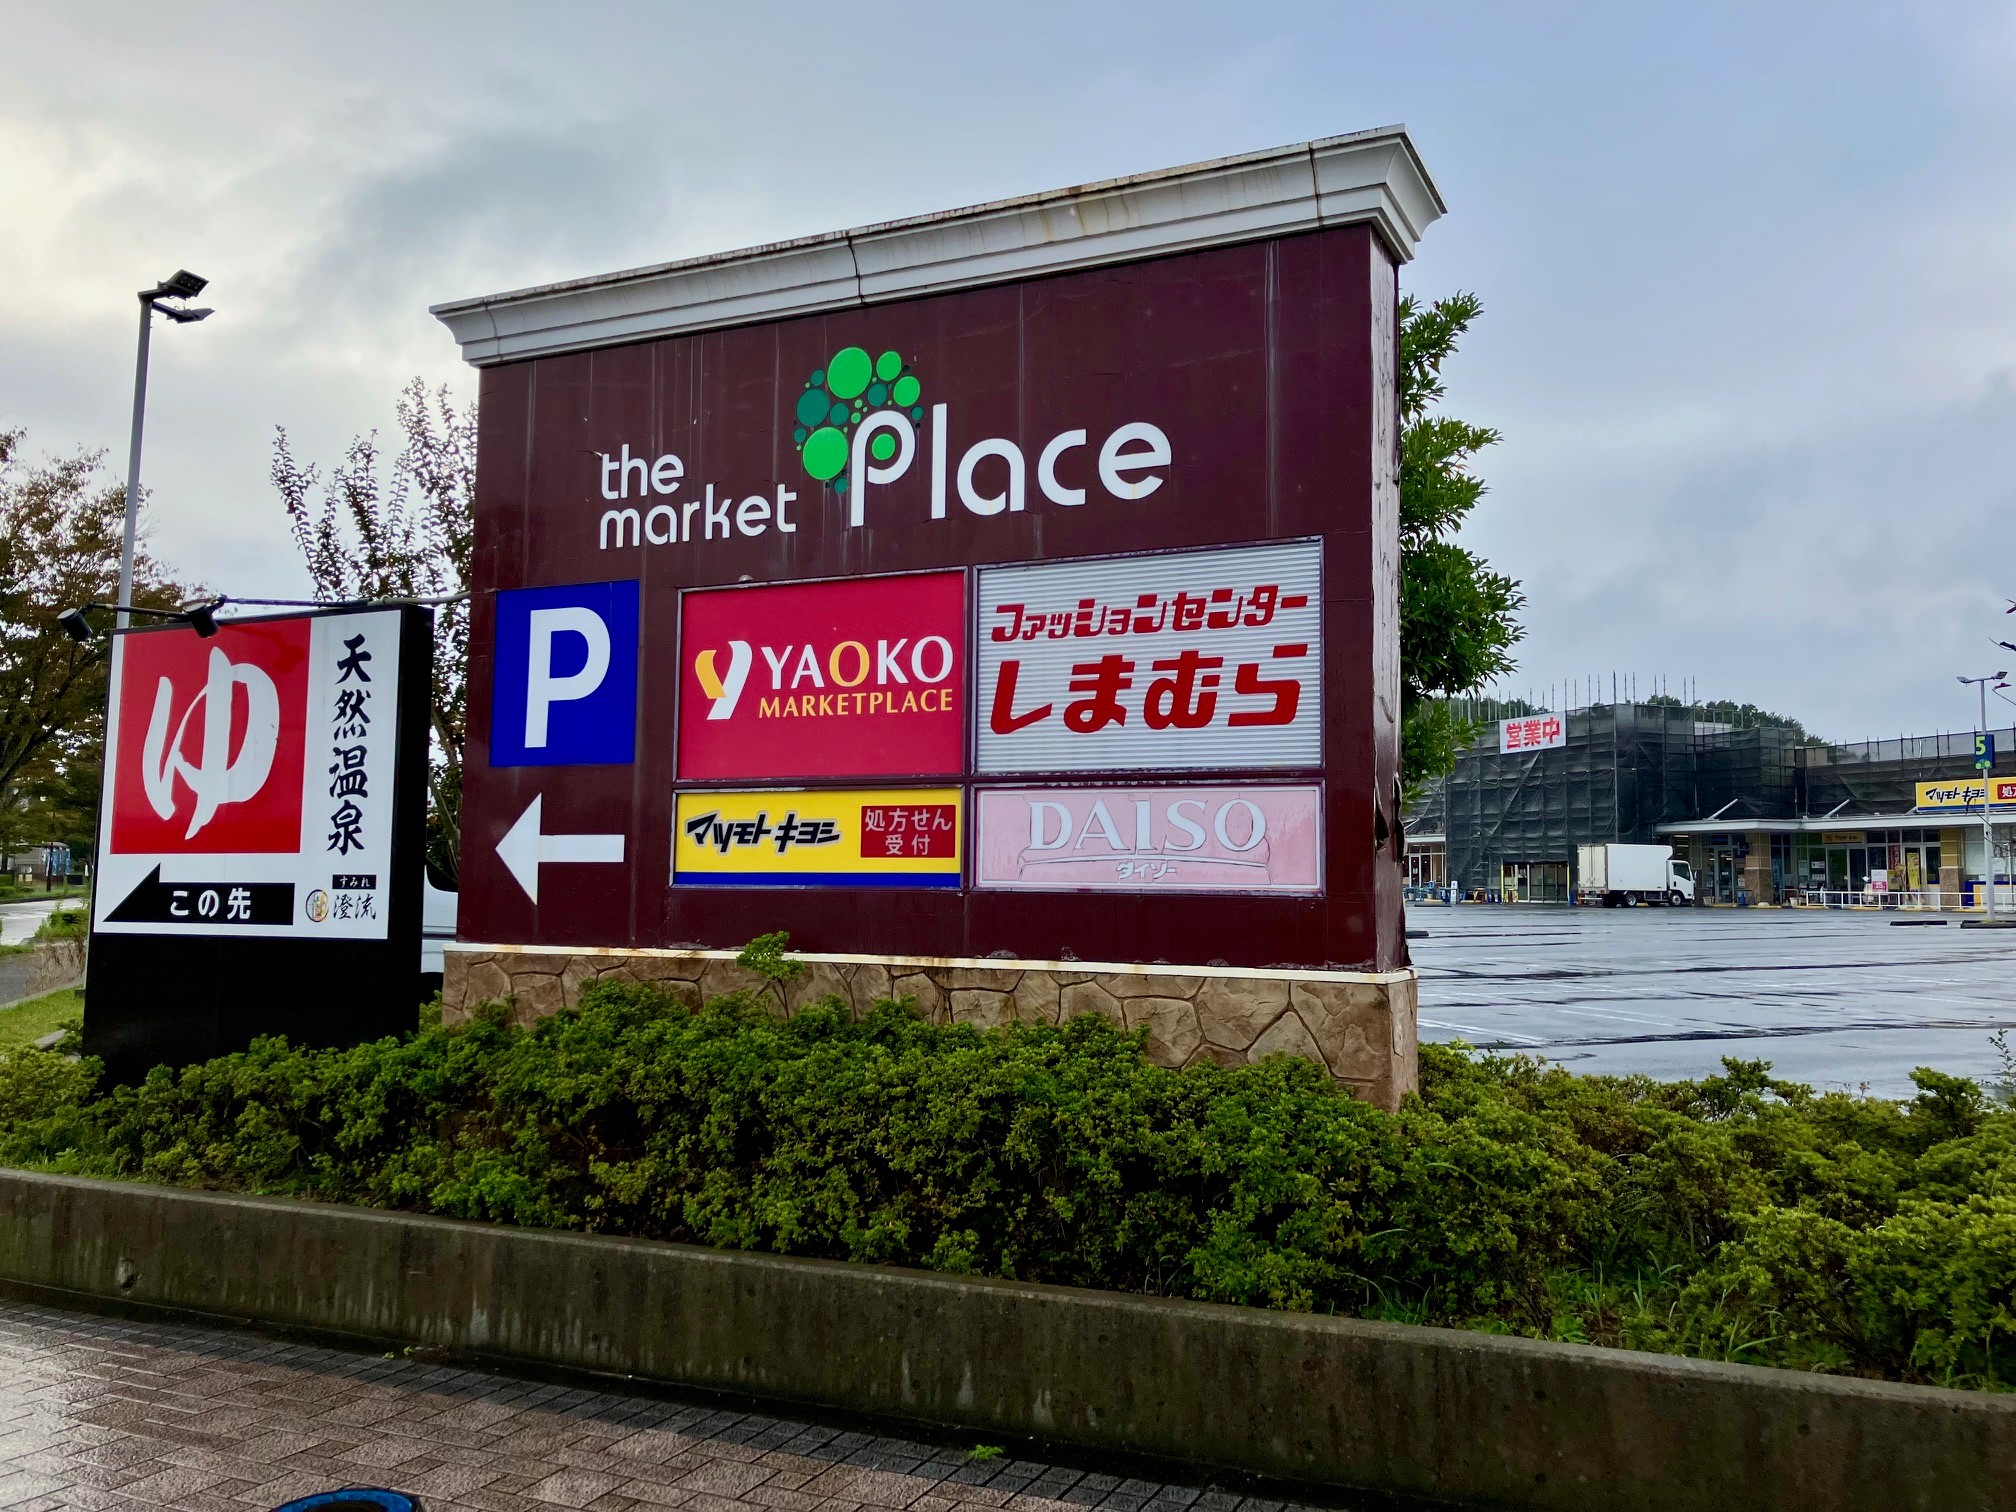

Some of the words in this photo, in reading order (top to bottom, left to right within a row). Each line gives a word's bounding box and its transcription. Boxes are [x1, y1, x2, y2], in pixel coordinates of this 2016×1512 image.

[602, 444, 684, 499] the
[600, 484, 797, 549] market
[991, 585, 1308, 642] ファッションセンター
[525, 607, 611, 748] P
[761, 636, 954, 690] YAOKO
[758, 689, 953, 718] MARKETPLACE
[990, 643, 1308, 734] しまむら
[142, 646, 280, 841] ゆ
[327, 633, 372, 856] 天然温泉
[1506, 717, 1560, 749] 営業中
[1975, 736, 1986, 755] 5
[686, 810, 840, 853] マツモトキヨシ
[865, 808, 952, 832] 処方せん
[1028, 797, 1267, 852] DAISO
[885, 833, 931, 855] 受付
[340, 875, 370, 888] すみれ
[1117, 862, 1177, 880] ダイソー
[170, 887, 251, 919] この先
[333, 893, 376, 920] 澄流
